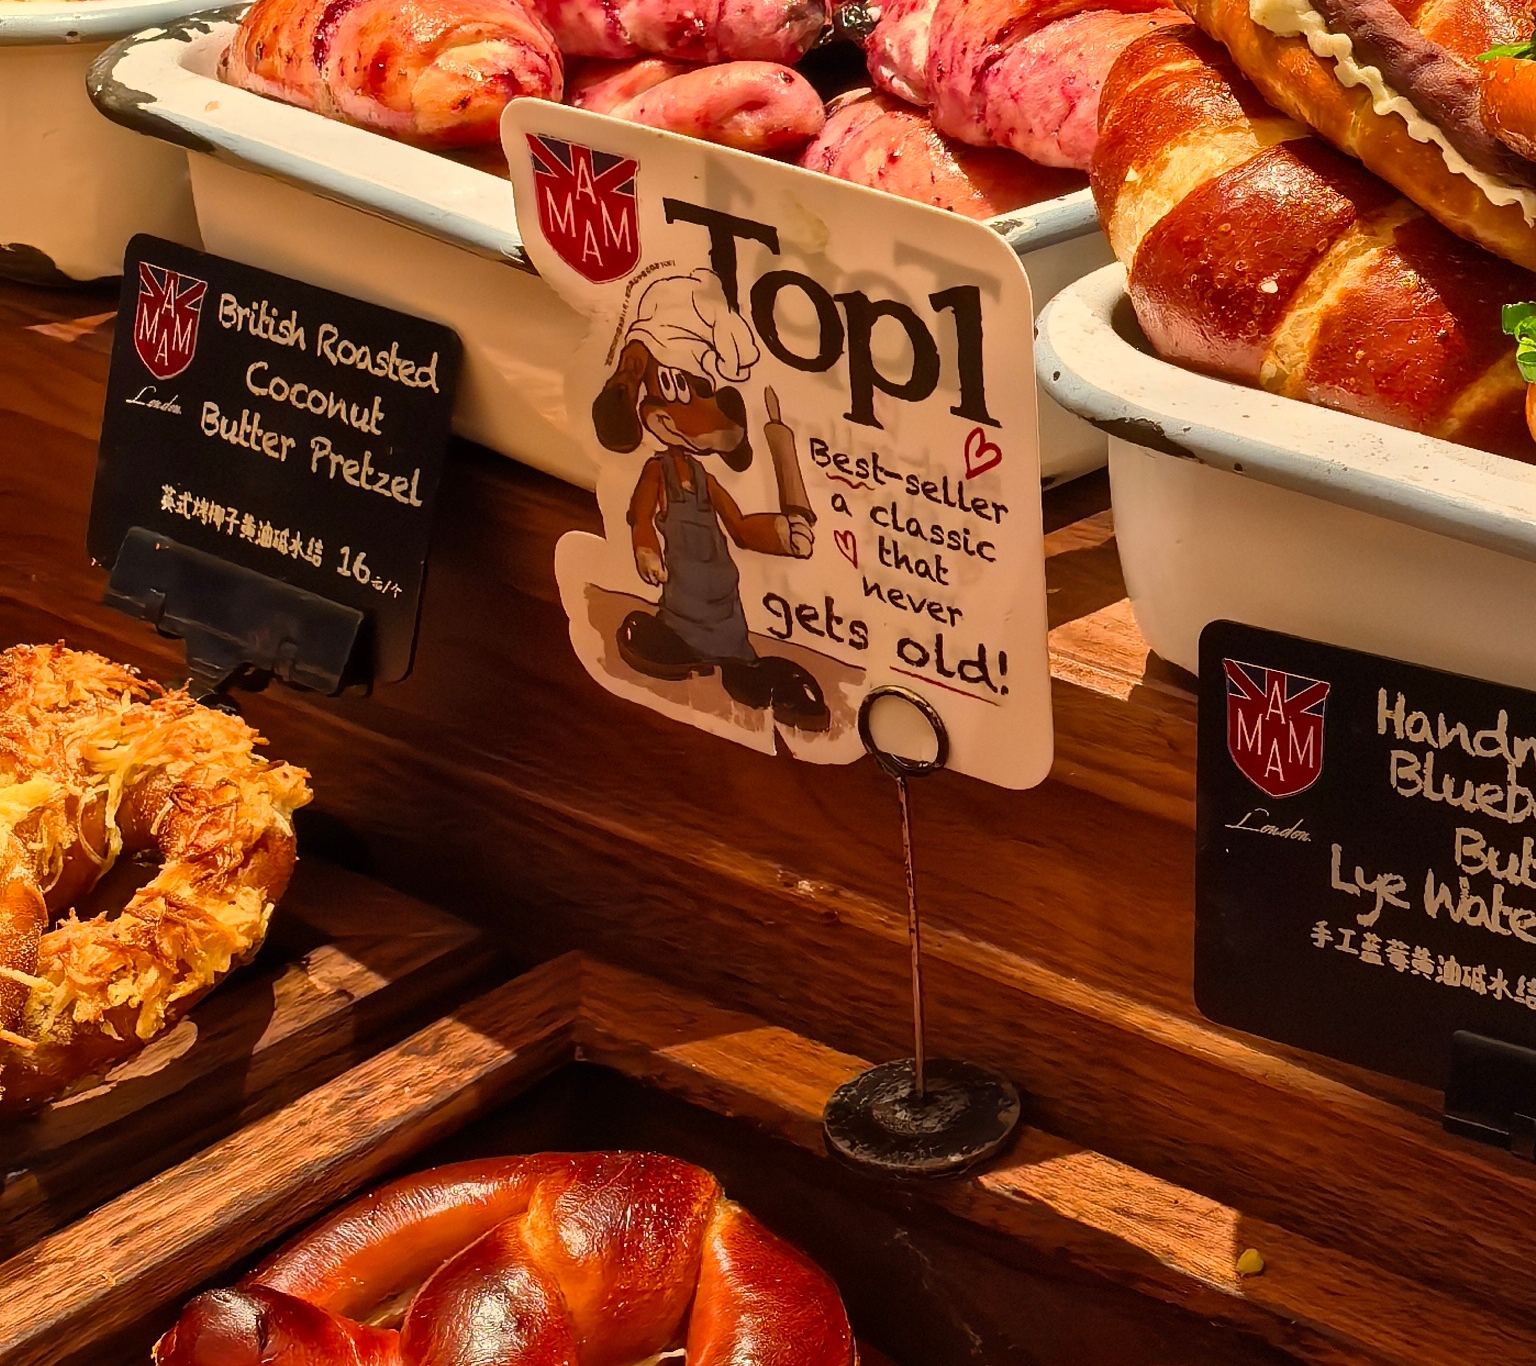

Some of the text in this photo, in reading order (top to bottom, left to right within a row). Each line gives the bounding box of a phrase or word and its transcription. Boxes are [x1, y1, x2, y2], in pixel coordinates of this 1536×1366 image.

[218, 292, 440, 394] British Roasted
[662, 196, 1003, 431] Top1
[246, 360, 386, 435] Coconut
[200, 401, 423, 507] Butter Pretzel
[809, 437, 1009, 524] Best-seller
[831, 492, 997, 563] a classic
[878, 535, 950, 586] that
[762, 591, 1010, 697] gets old!
[862, 575, 965, 628] never
[1330, 843, 1411, 926] Lye
